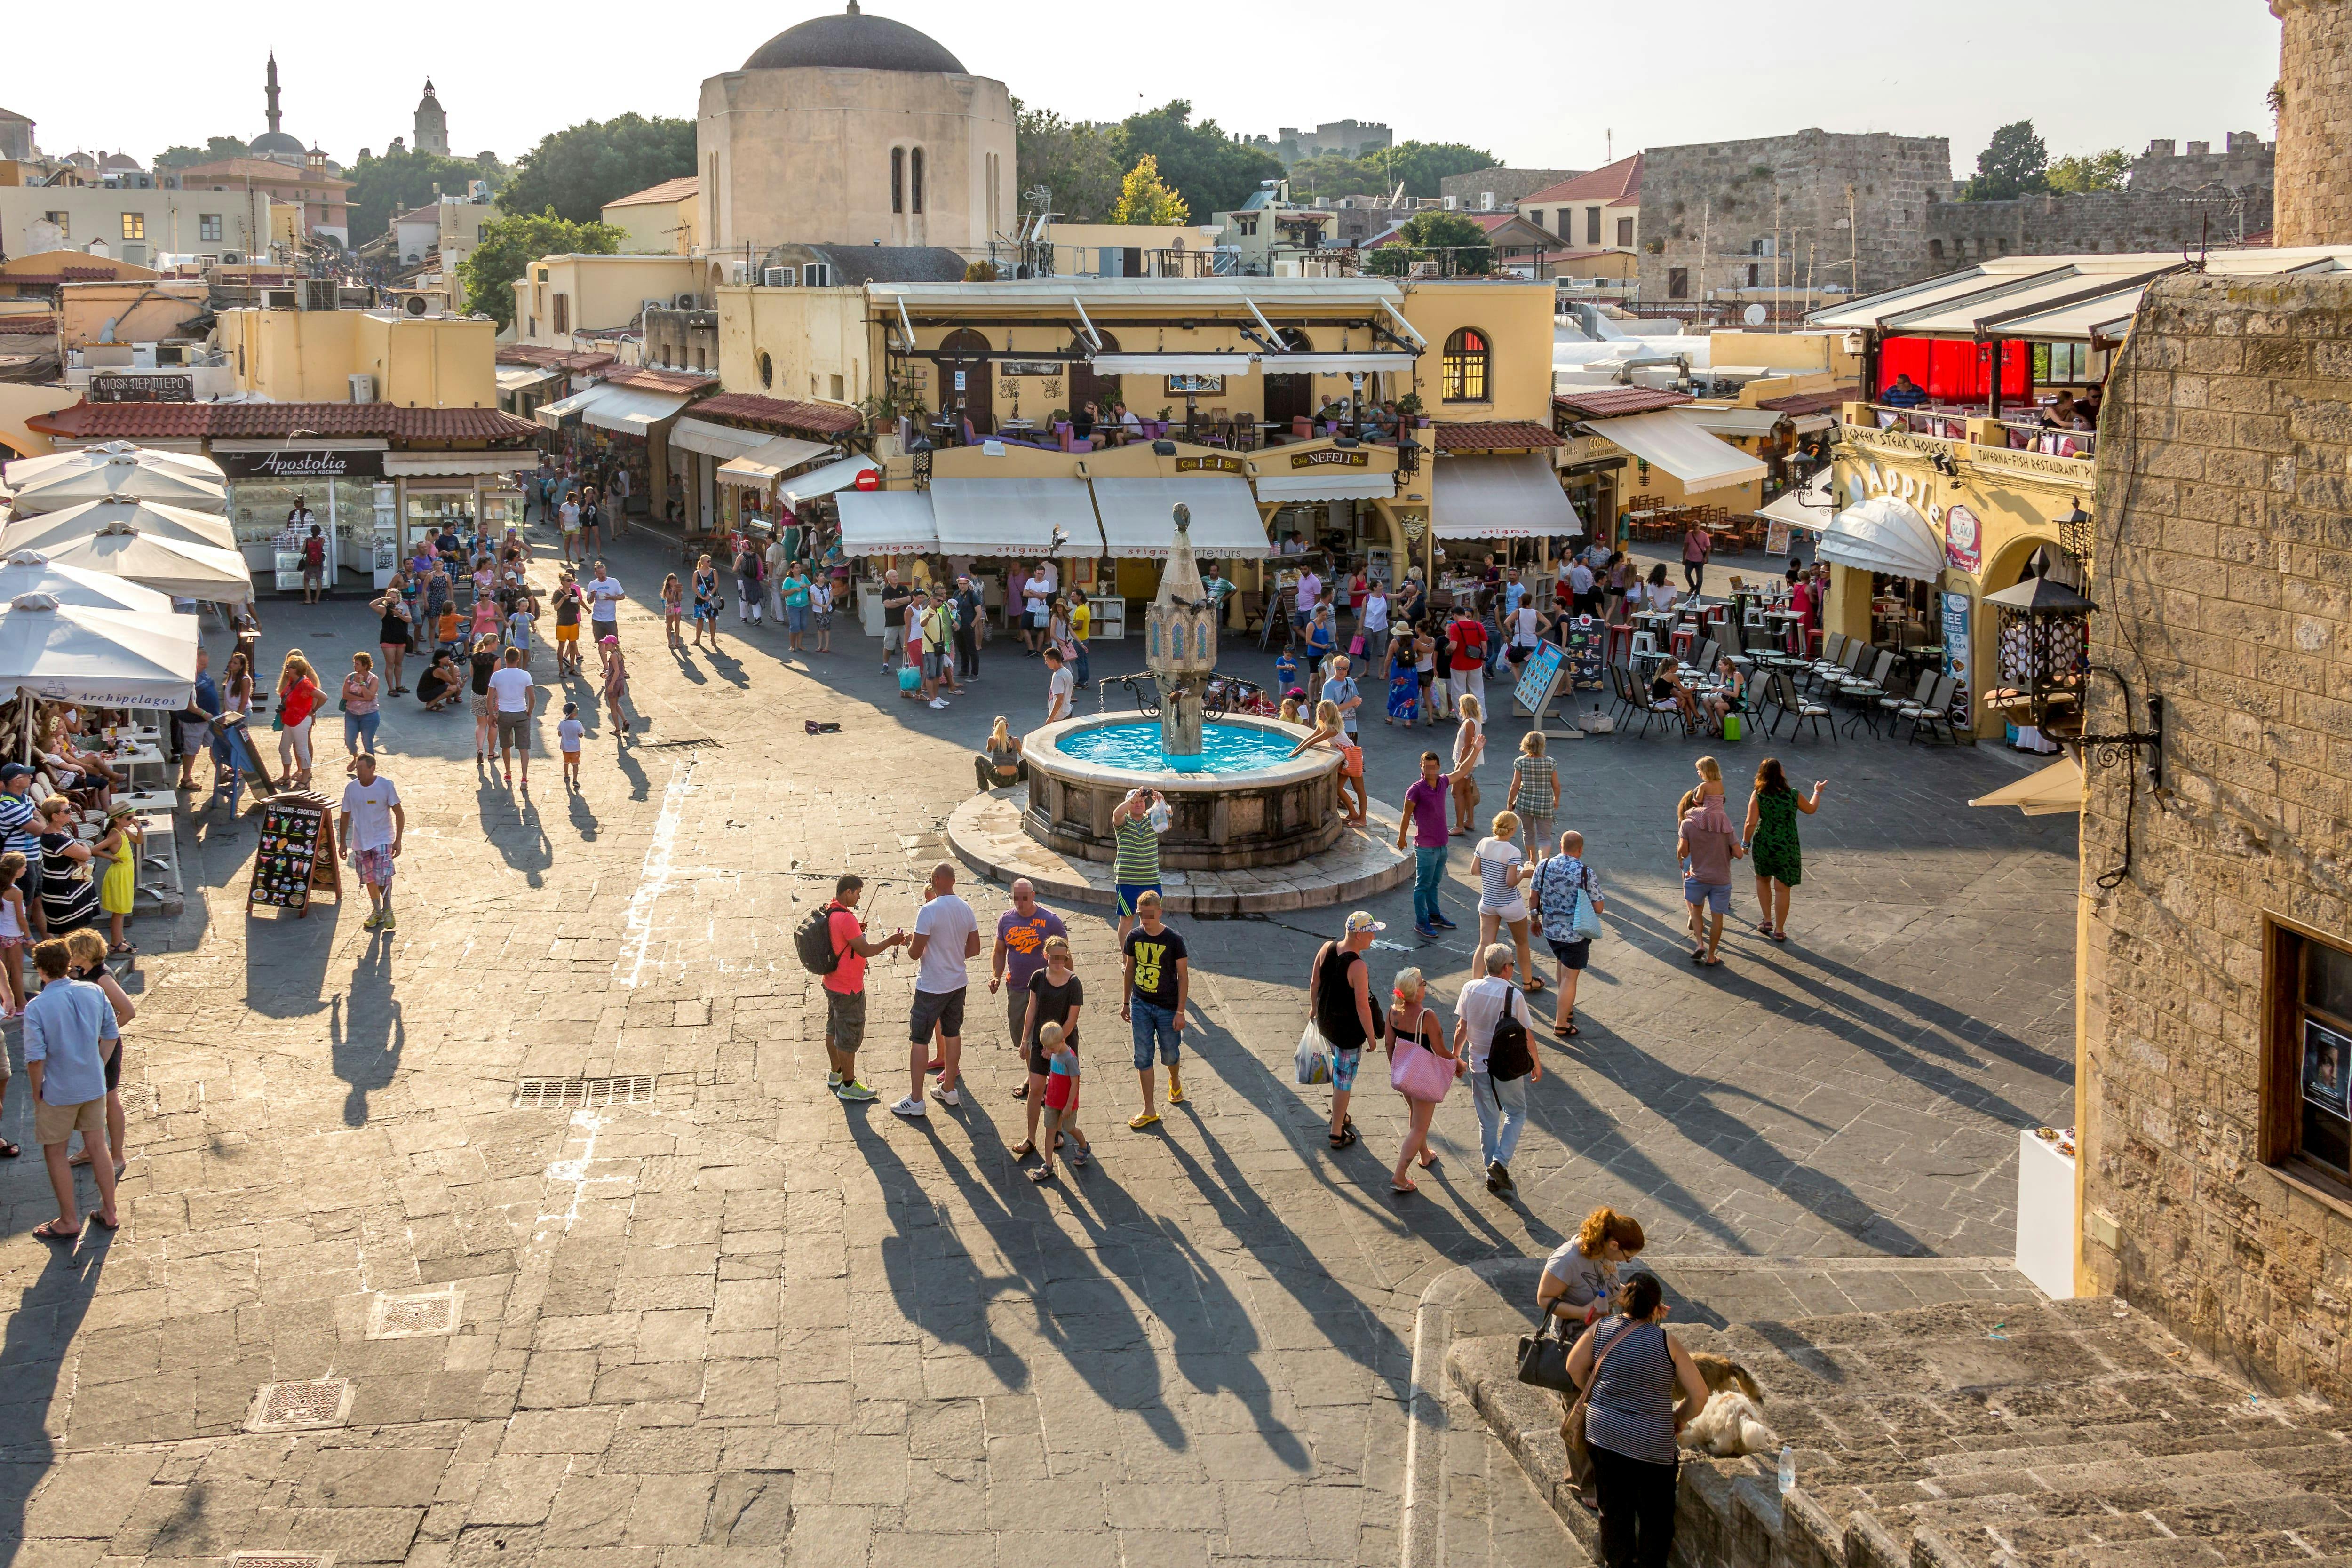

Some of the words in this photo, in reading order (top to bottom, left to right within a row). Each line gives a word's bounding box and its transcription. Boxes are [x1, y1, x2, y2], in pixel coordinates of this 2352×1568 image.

[99, 378, 128, 390] KIOSK
[1849, 428, 1875, 444] GREEK
[1879, 433, 1909, 450] STEAK
[1913, 439, 1948, 455] HOUSE
[1308, 452, 1351, 464] NEFELI
[1564, 446, 1578, 457] FURS
[250, 451, 347, 475] Apostolia
[1978, 449, 2029, 469] TAVERNA-FISH
[2031, 459, 2078, 477] RESTAURANT
[1869, 462, 1939, 526] Apple
[1952, 524, 1973, 539] PLAKA
[996, 546, 1048, 554] stigma
[78, 692, 177, 707] Archipelagos
[297, 808, 322, 817] COCKTAILS
[1029, 918, 1047, 928] JPN
[1134, 941, 1166, 965] NY
[1135, 964, 1160, 989] 83
